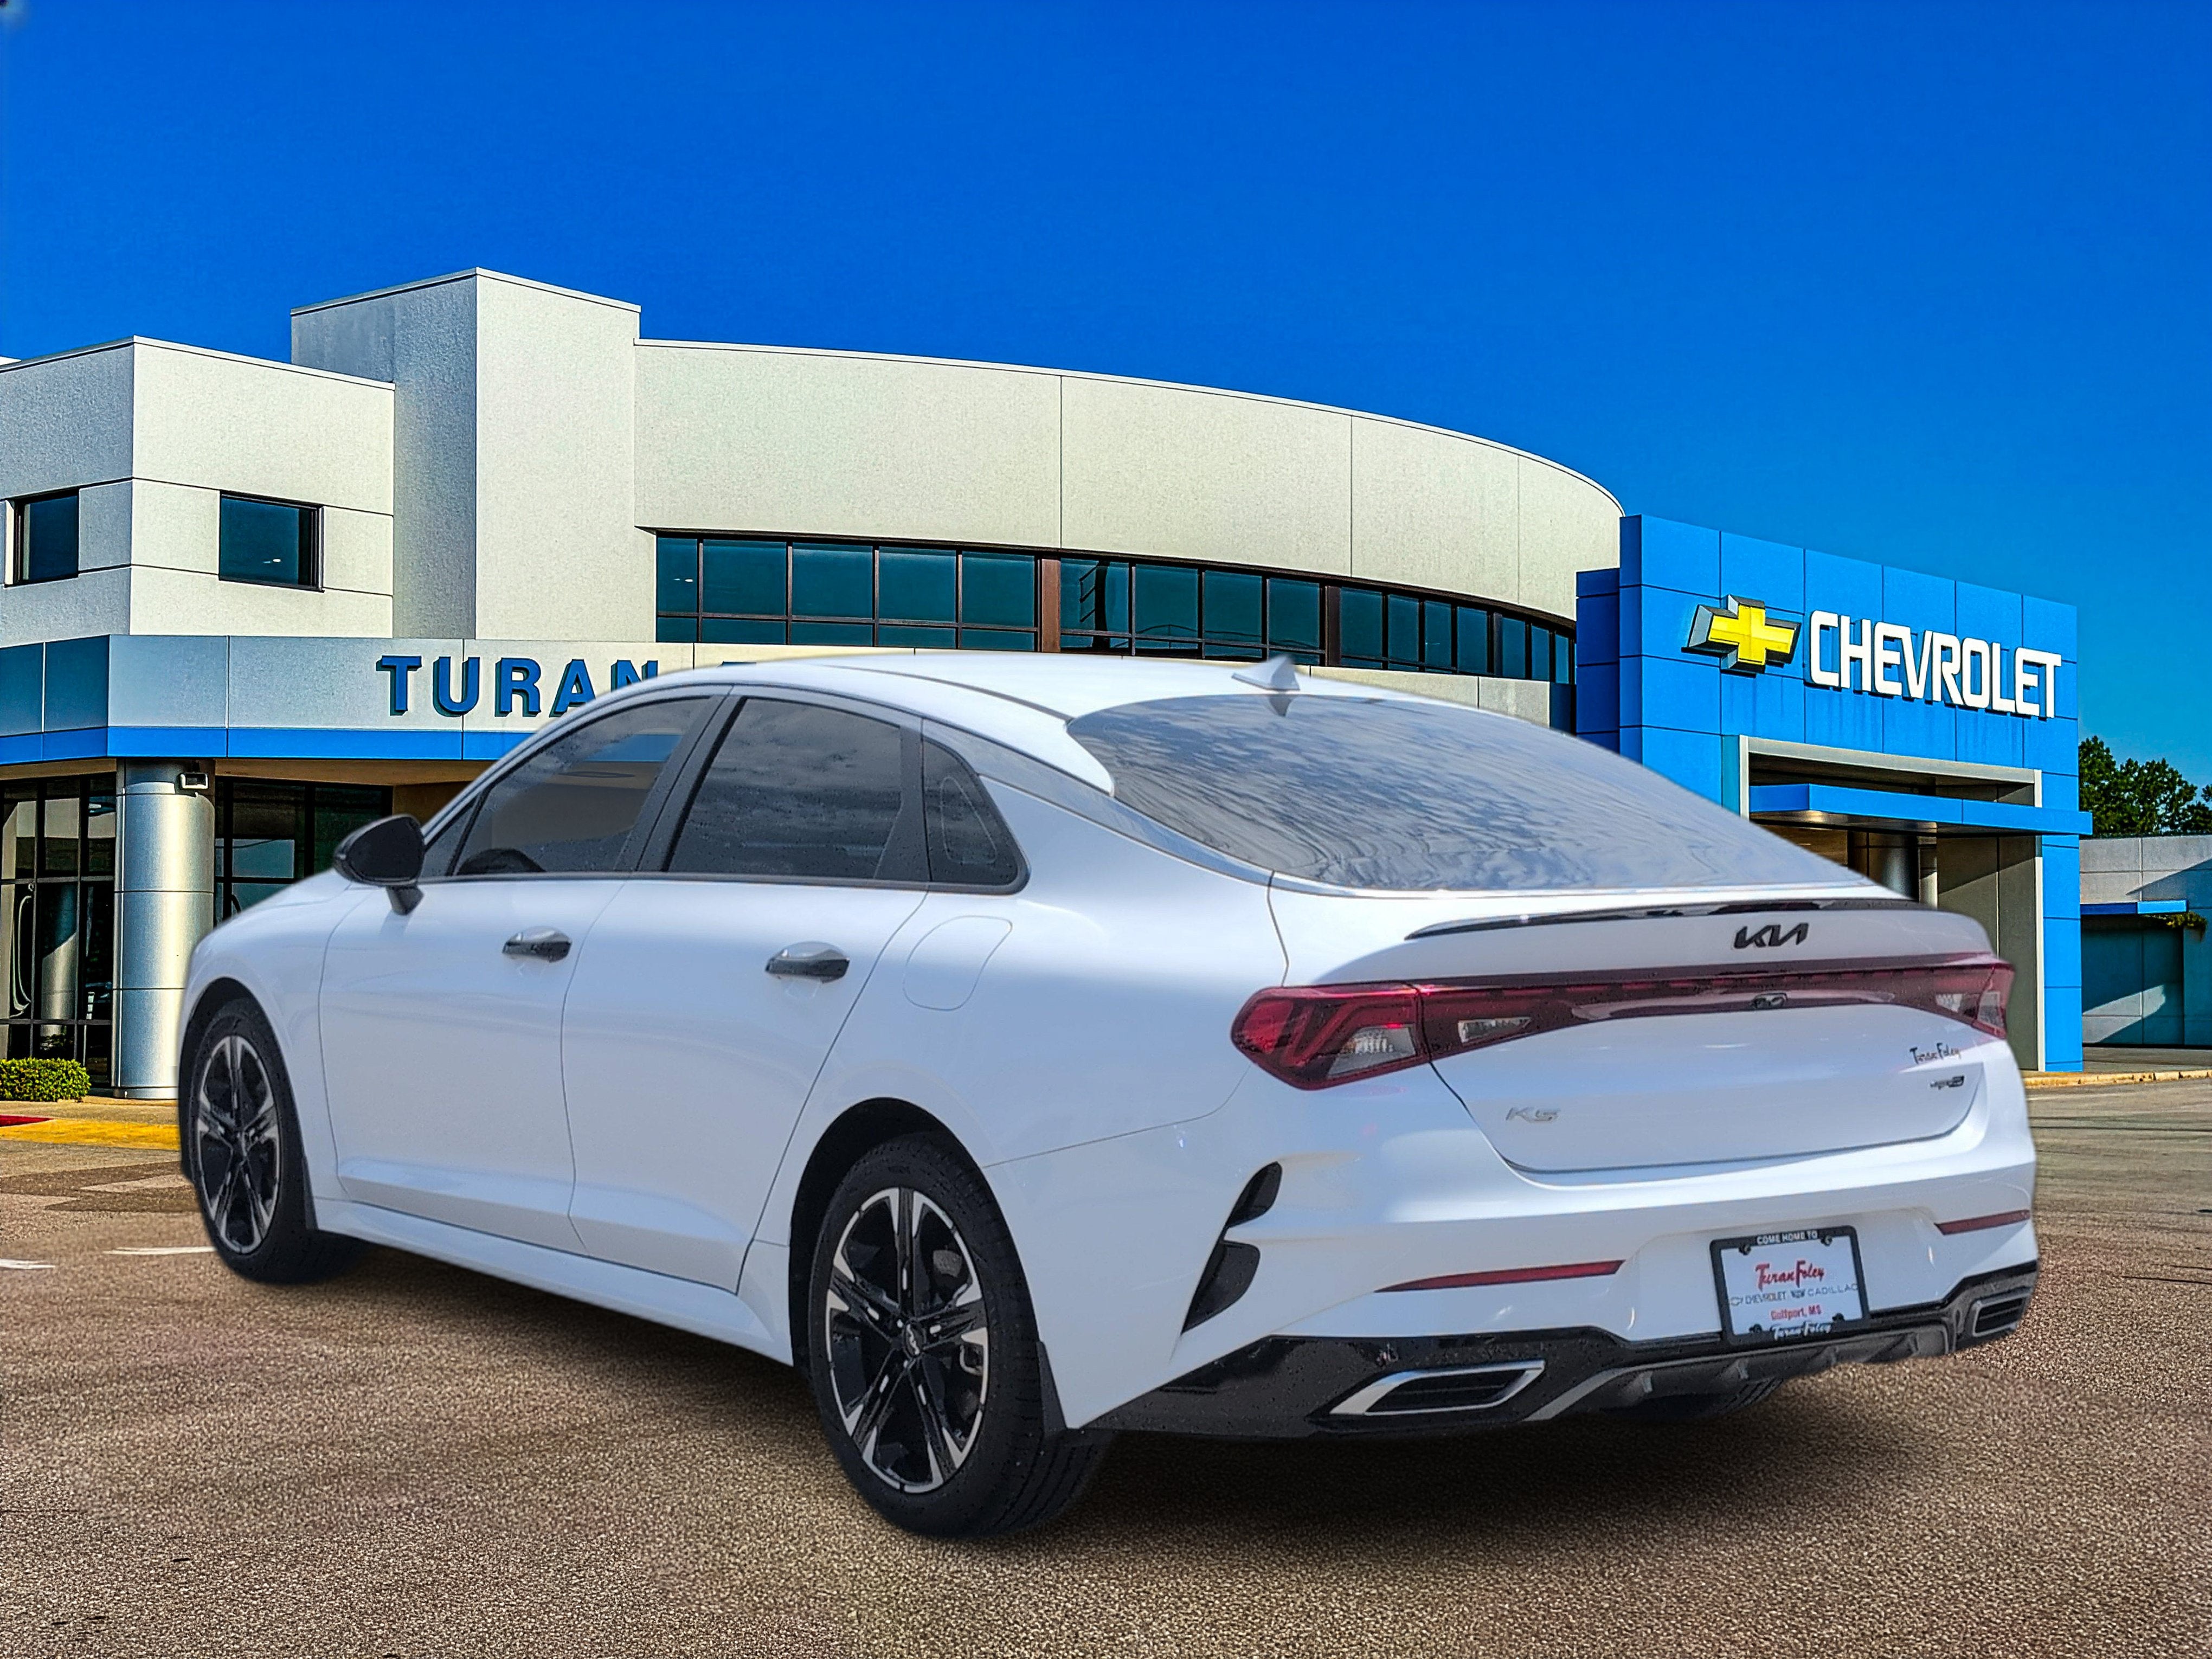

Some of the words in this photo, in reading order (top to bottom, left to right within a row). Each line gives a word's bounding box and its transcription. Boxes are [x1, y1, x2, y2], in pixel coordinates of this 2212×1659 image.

[1810, 610, 2061, 718] CHEVROLET
[1734, 923, 1809, 949] KIA
[1506, 1107, 1561, 1123] K5
[1757, 1234, 1781, 1245] COME
[1782, 1232, 1805, 1242] HOME
[1807, 1230, 1818, 1239] TO
[1808, 1283, 1857, 1297] CADILLAC
